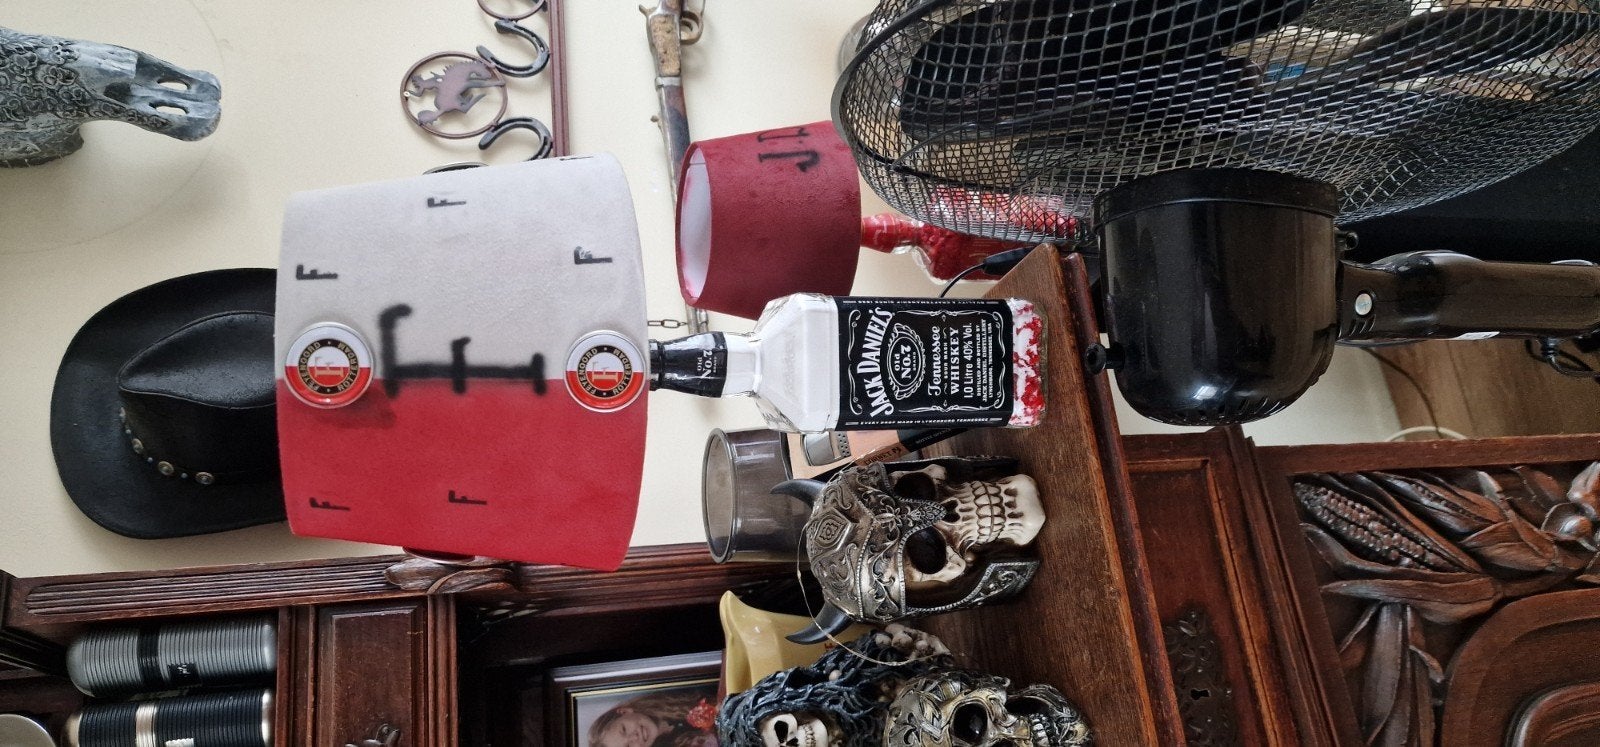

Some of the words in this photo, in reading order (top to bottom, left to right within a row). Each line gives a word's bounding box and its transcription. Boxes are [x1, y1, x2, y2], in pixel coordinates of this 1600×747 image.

[426, 196, 467, 208] F
[573, 245, 613, 265] F
[296, 264, 338, 280] F
[856, 306, 894, 374] DANIEL'S
[962, 322, 973, 339] Vol.
[975, 324, 981, 332] BY
[701, 350, 713, 379] No.7
[900, 344, 912, 380] No.7
[927, 325, 942, 397] Tennessee
[949, 326, 960, 395] WHISKEY
[963, 340, 974, 361] 40%
[299, 341, 321, 391] FEYENOORD
[337, 342, 358, 391] ROTTERDAM
[578, 348, 598, 395] FEYENOORD
[612, 348, 632, 395] ROTTERDAM
[963, 363, 974, 384] Litre
[864, 374, 895, 418] JACK
[309, 497, 350, 512] F
[448, 490, 488, 505] F
